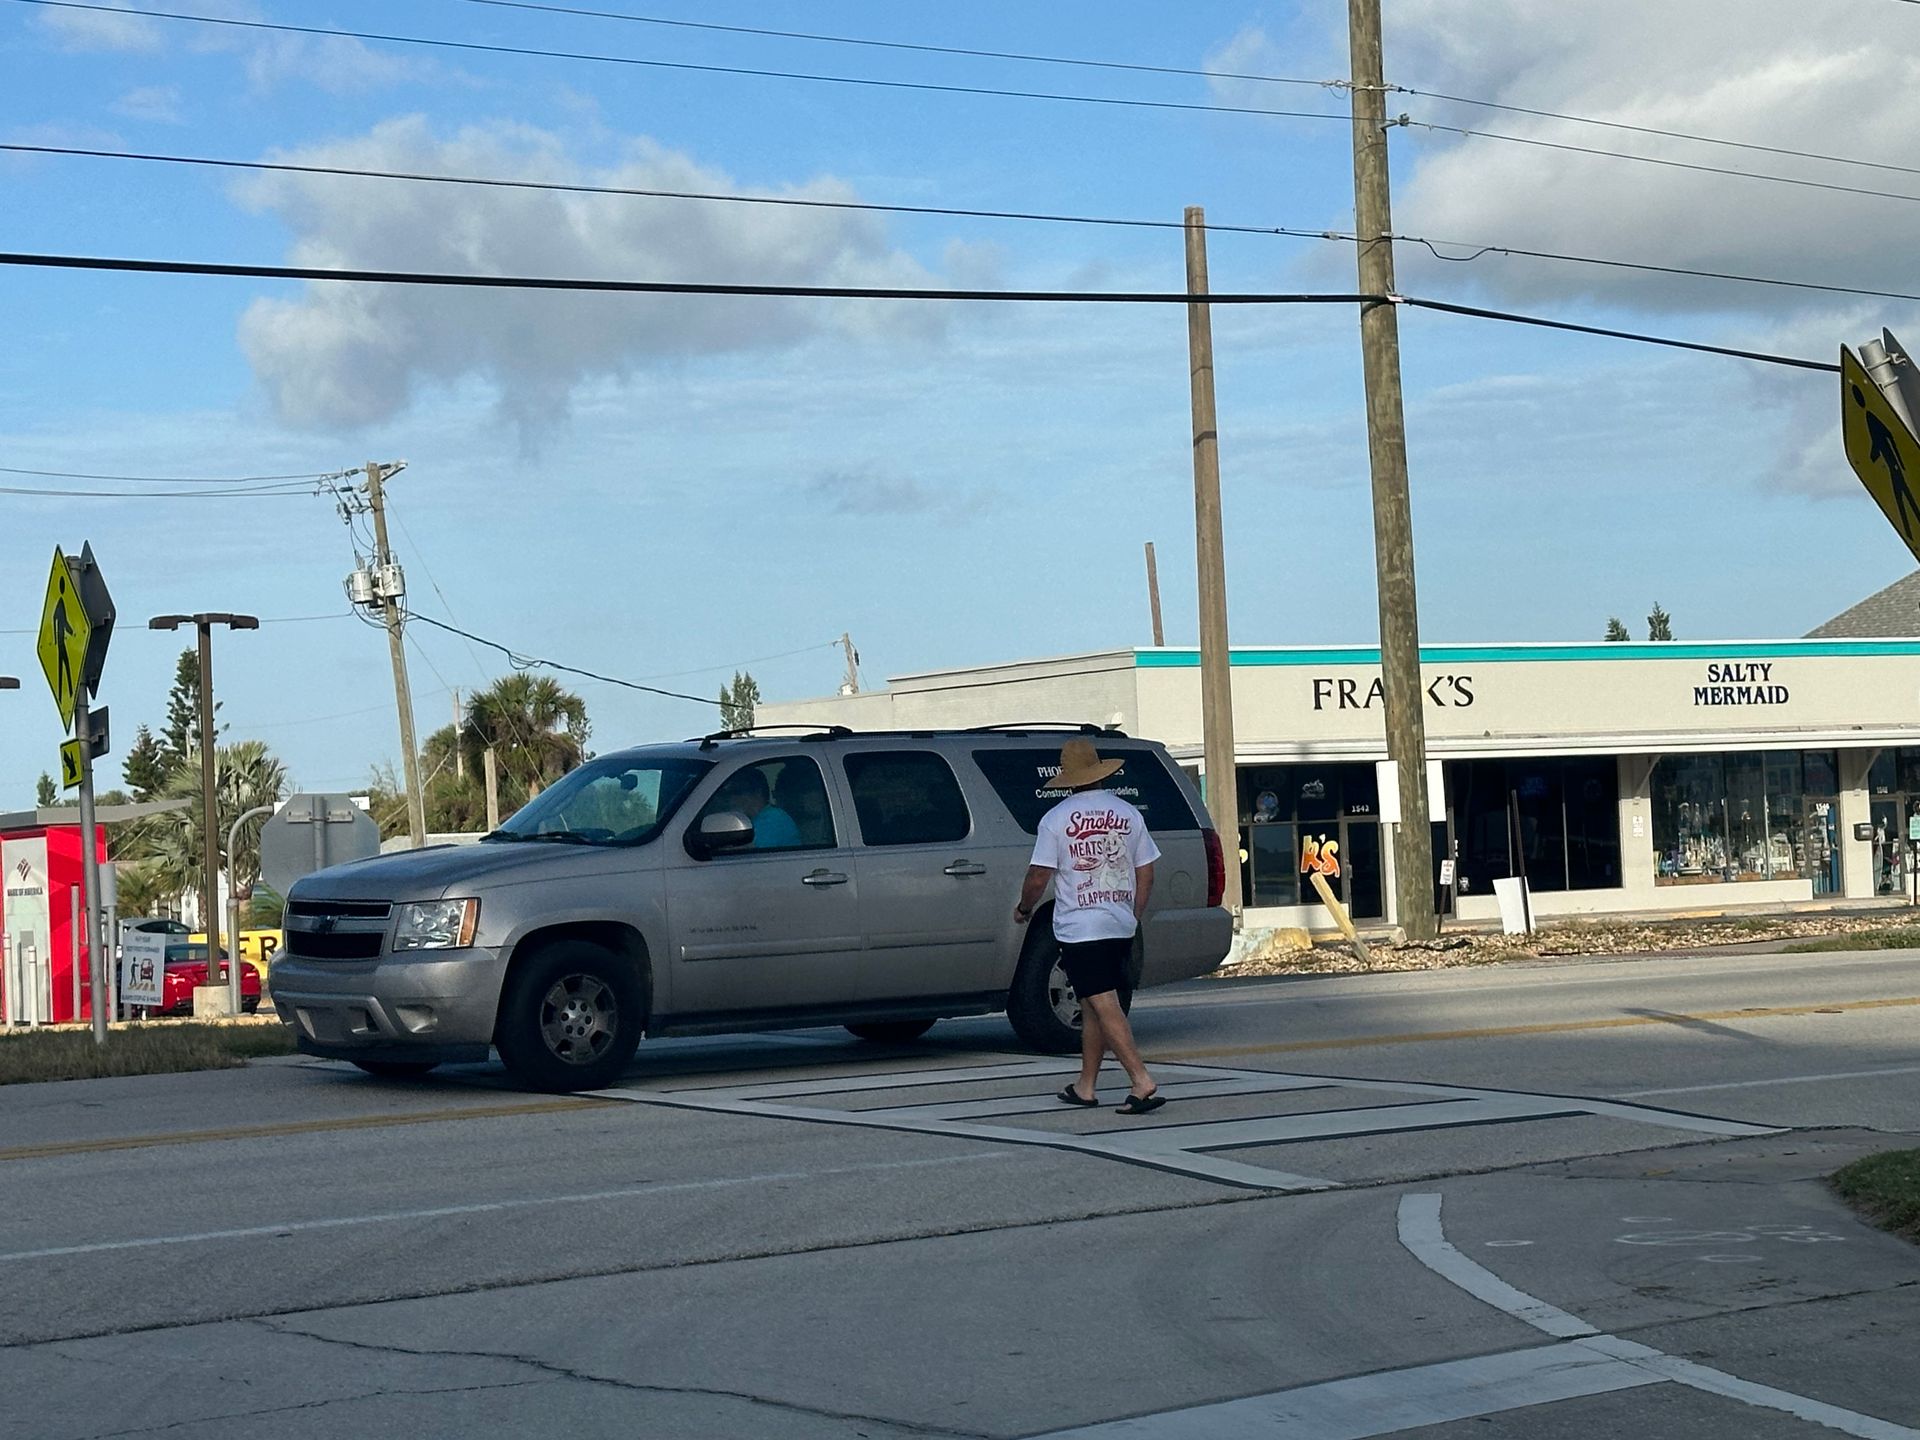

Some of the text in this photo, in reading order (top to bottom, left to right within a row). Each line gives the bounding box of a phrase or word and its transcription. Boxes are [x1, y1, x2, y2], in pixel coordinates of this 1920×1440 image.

[1707, 663, 1773, 682] SALTY
[1313, 675, 1474, 710] FRAK'S
[1693, 685, 1789, 706] MERMAID
[1069, 840, 1103, 858] MEATS
